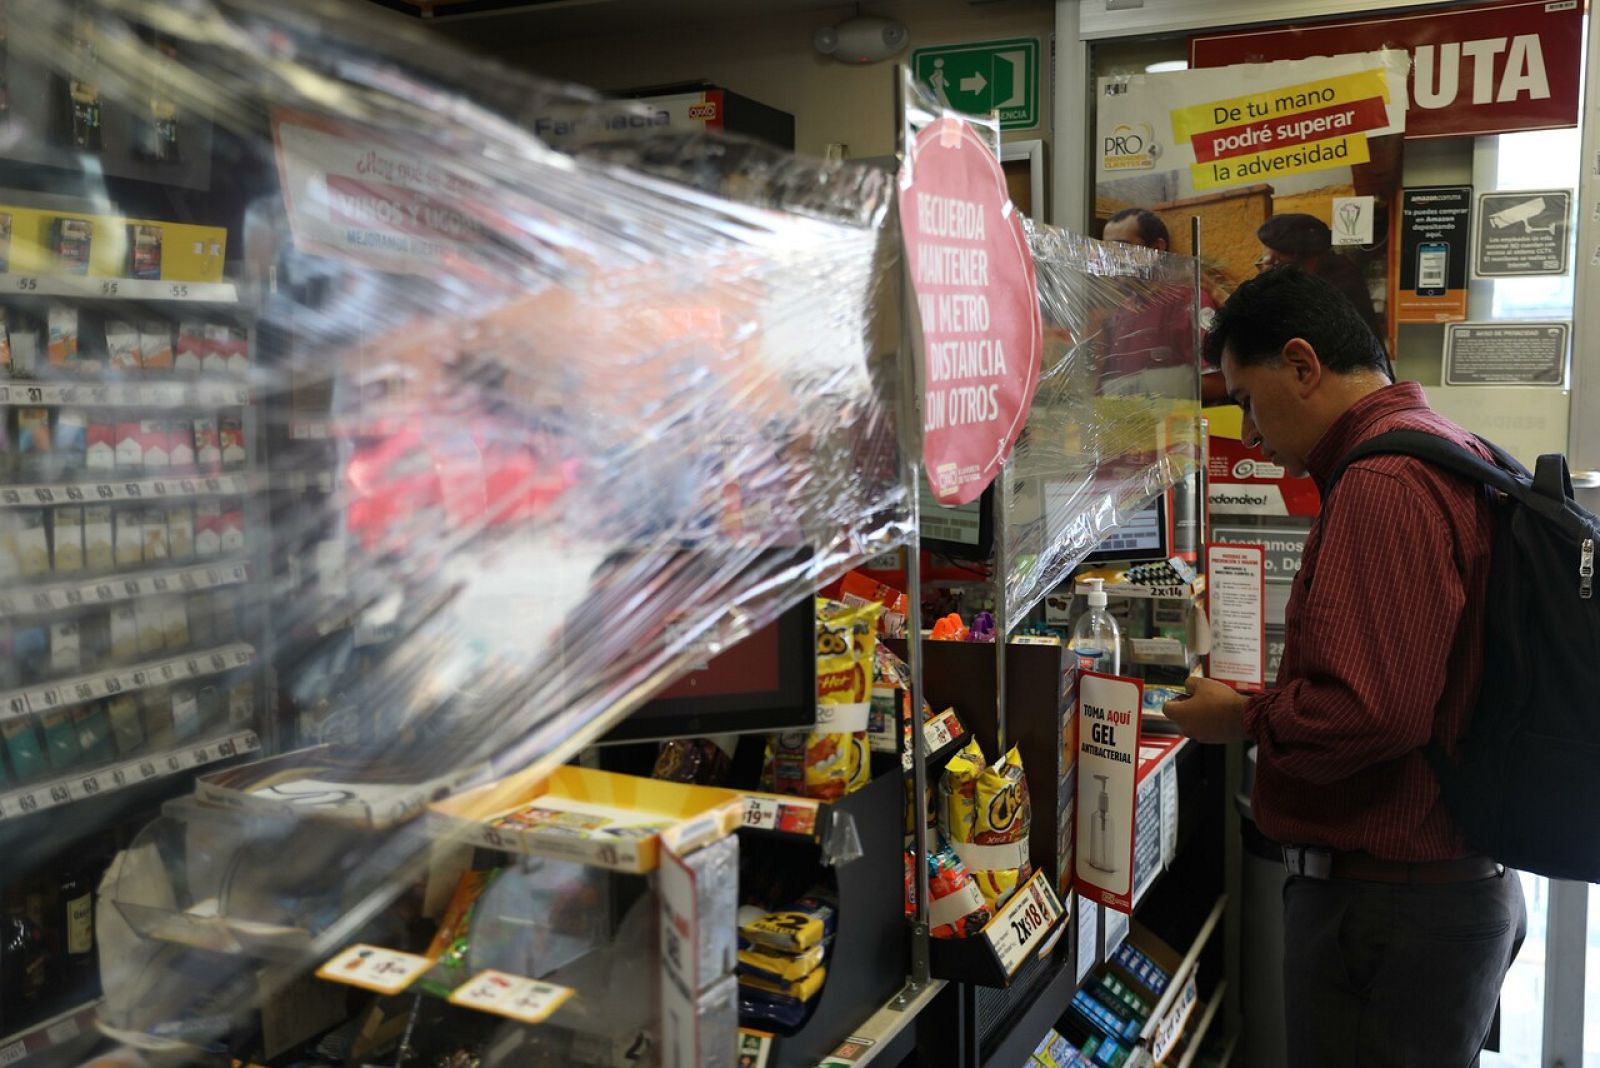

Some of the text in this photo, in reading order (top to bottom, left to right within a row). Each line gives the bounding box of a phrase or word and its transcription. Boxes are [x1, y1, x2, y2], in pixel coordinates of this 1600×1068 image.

[1407, 33, 1551, 110] UTA
[534, 106, 671, 137] Faracia
[994, 110, 1028, 121] ENCIA
[1214, 88, 1335, 124] De tu mano
[1104, 135, 1142, 155] PRO
[1213, 111, 1356, 157] podré superar
[1213, 138, 1348, 181] la adversidad
[917, 193, 985, 241] RECUERDA
[918, 242, 989, 287] MANTENER
[939, 294, 991, 333] METRO
[931, 339, 1007, 382] DISTANCIA
[949, 383, 998, 427] OTROS
[1209, 494, 1267, 506] edondeo!
[1218, 536, 1304, 552] Atamos
[1083, 703, 1132, 727] TOMA AQUÍ
[1091, 723, 1116, 747] GEL
[1081, 742, 1132, 765] ANTIBACTERIAL
